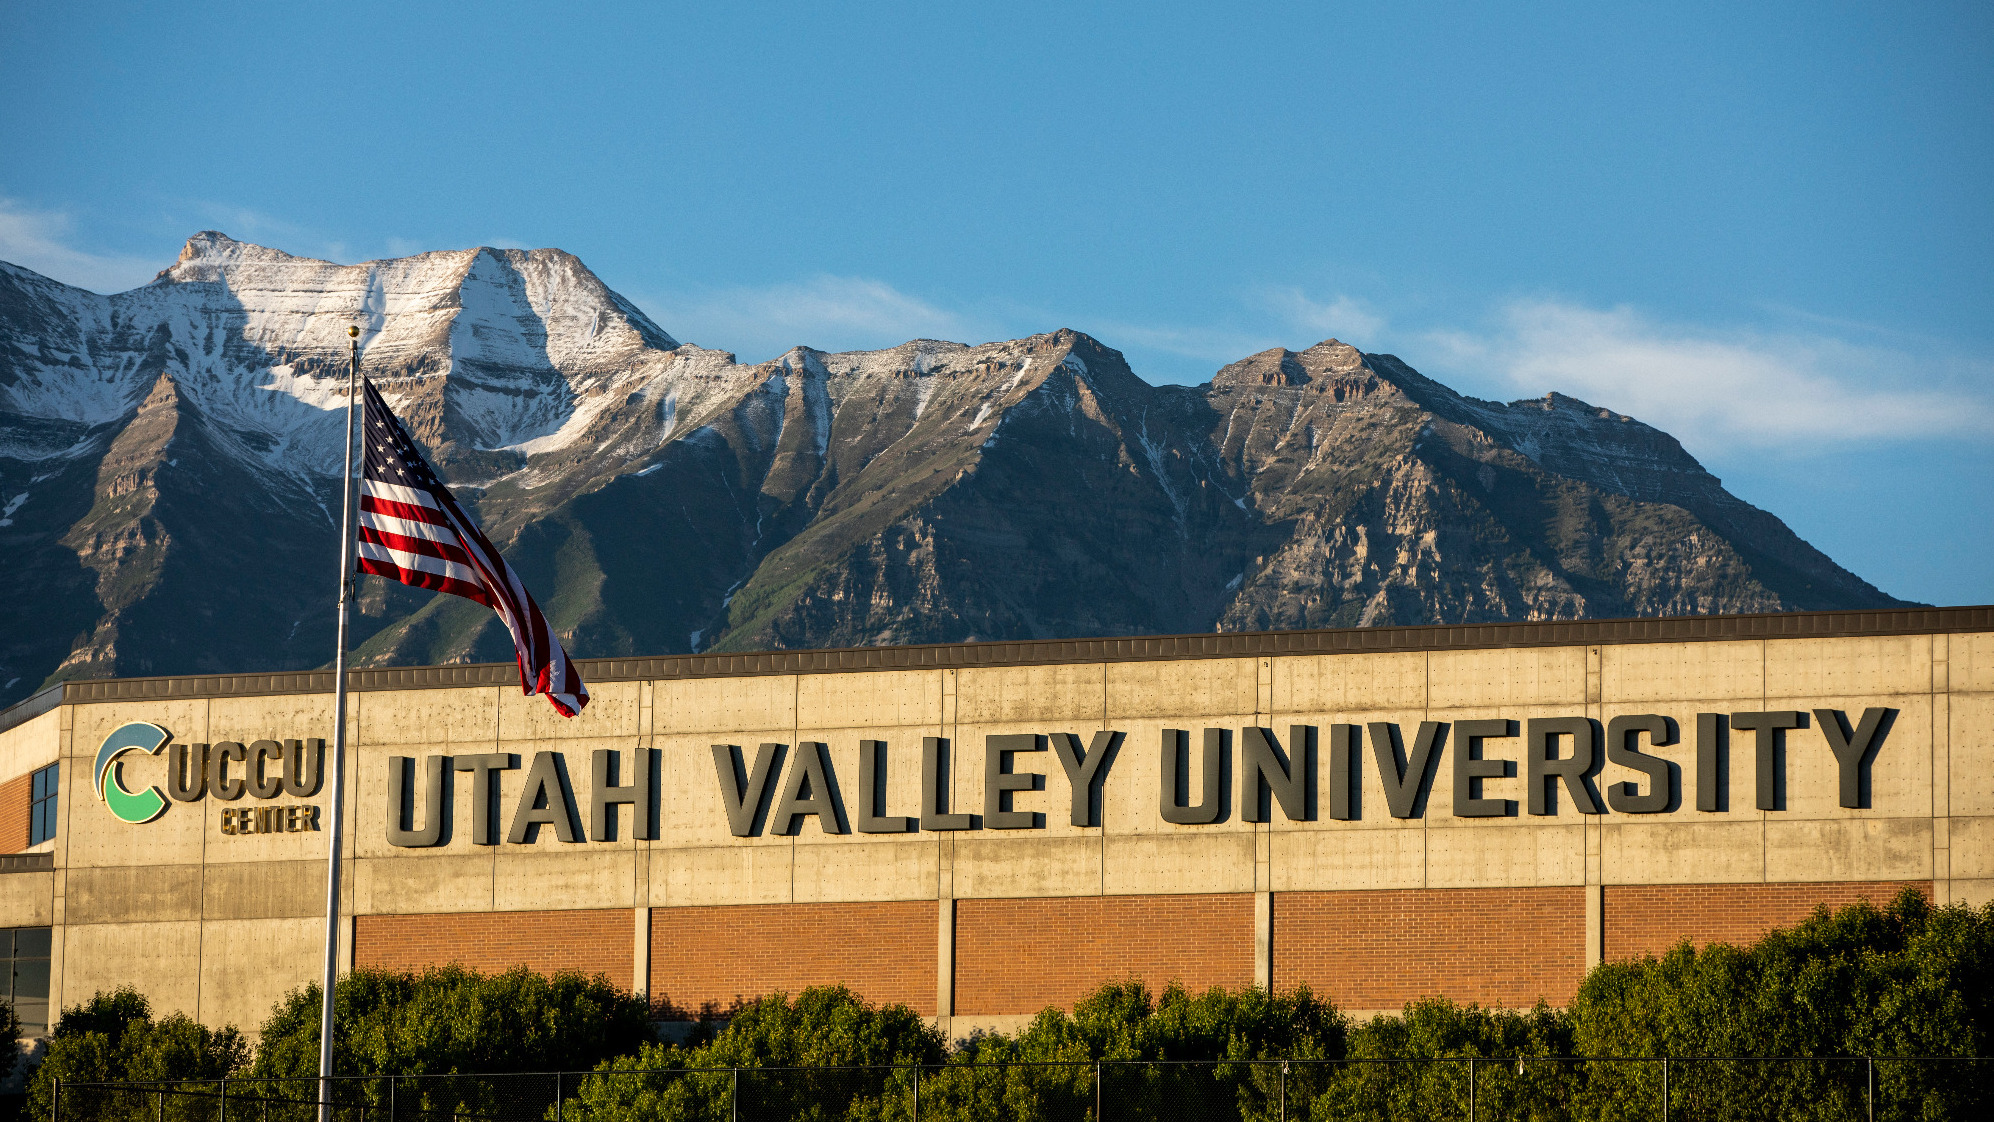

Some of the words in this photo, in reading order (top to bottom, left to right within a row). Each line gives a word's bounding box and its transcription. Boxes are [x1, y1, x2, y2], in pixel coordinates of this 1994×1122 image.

[167, 737, 322, 802] UCCU
[386, 748, 656, 847] UTAH
[711, 731, 1124, 837] VALLEY
[1160, 707, 1896, 824] UNIVERSITY
[220, 804, 317, 835] CENTER
